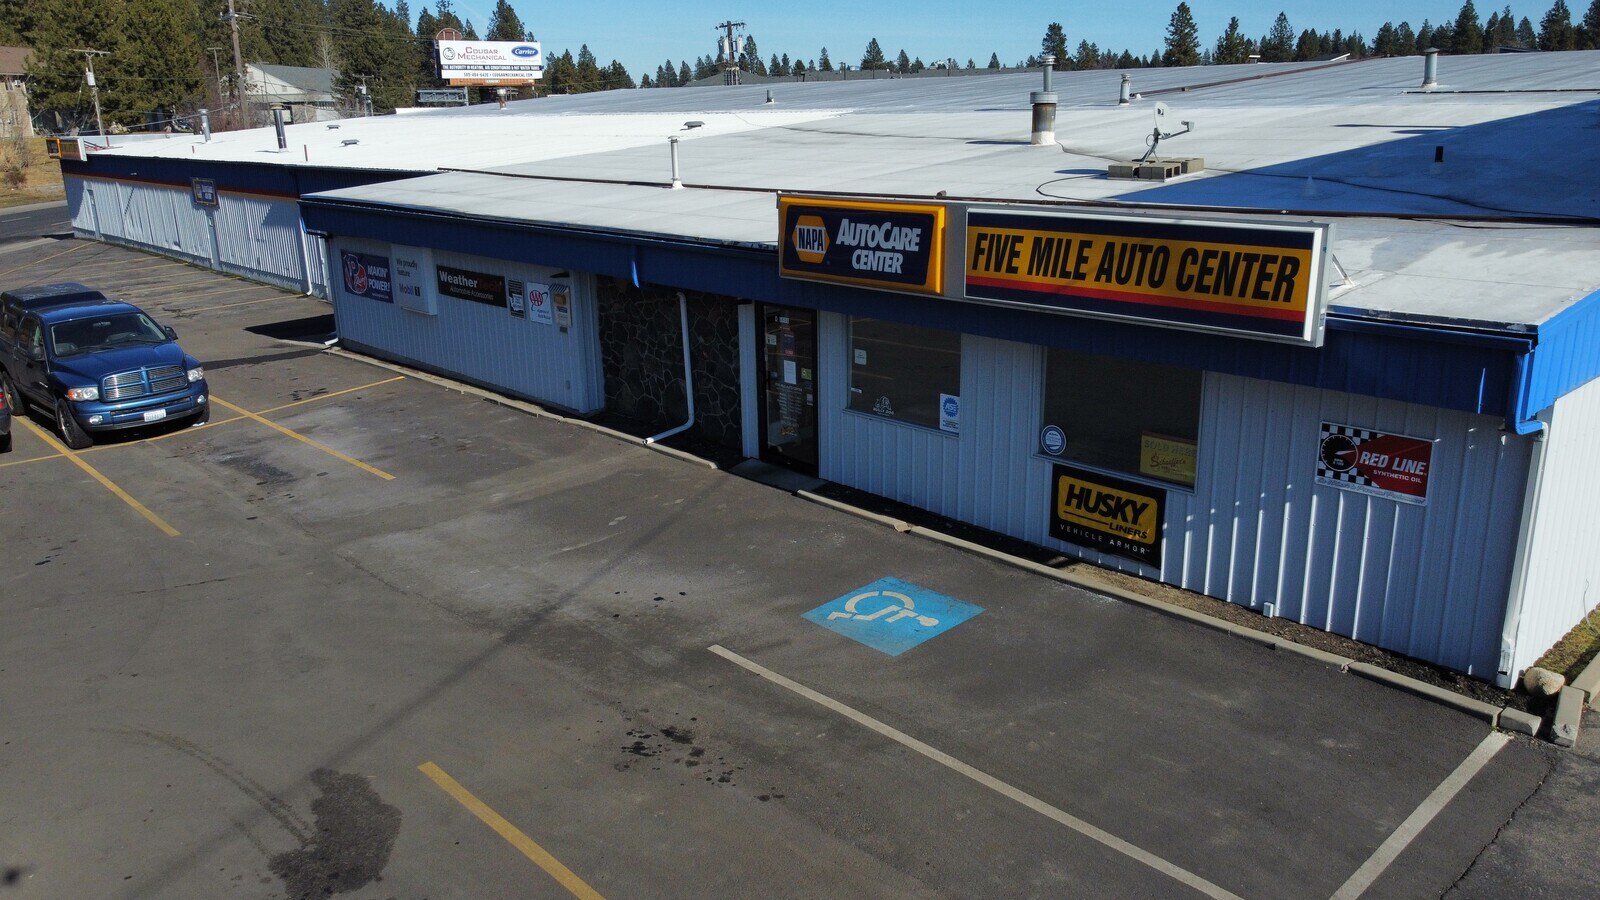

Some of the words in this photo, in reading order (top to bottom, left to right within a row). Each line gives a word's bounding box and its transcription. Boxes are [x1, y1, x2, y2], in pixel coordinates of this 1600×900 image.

[798, 227, 825, 252] NAPA
[851, 249, 904, 275] CENTER
[971, 232, 1025, 274] FIVE
[1026, 236, 1093, 281] MILE
[1093, 242, 1171, 289] AUTO
[1175, 247, 1301, 303] CENTER
[368, 278, 391, 292] POWER!
[399, 283, 414, 296] Mobil
[944, 402, 957, 412] ASE
[1359, 451, 1389, 468] RED
[1392, 457, 1427, 475] LINE
[1373, 469, 1409, 481] SYNTHETIC
[1410, 476, 1423, 484] OIL
[1064, 483, 1149, 526] HUSKY
[1060, 524, 1103, 542] VEHICLE
[1109, 522, 1148, 539] LINERS
